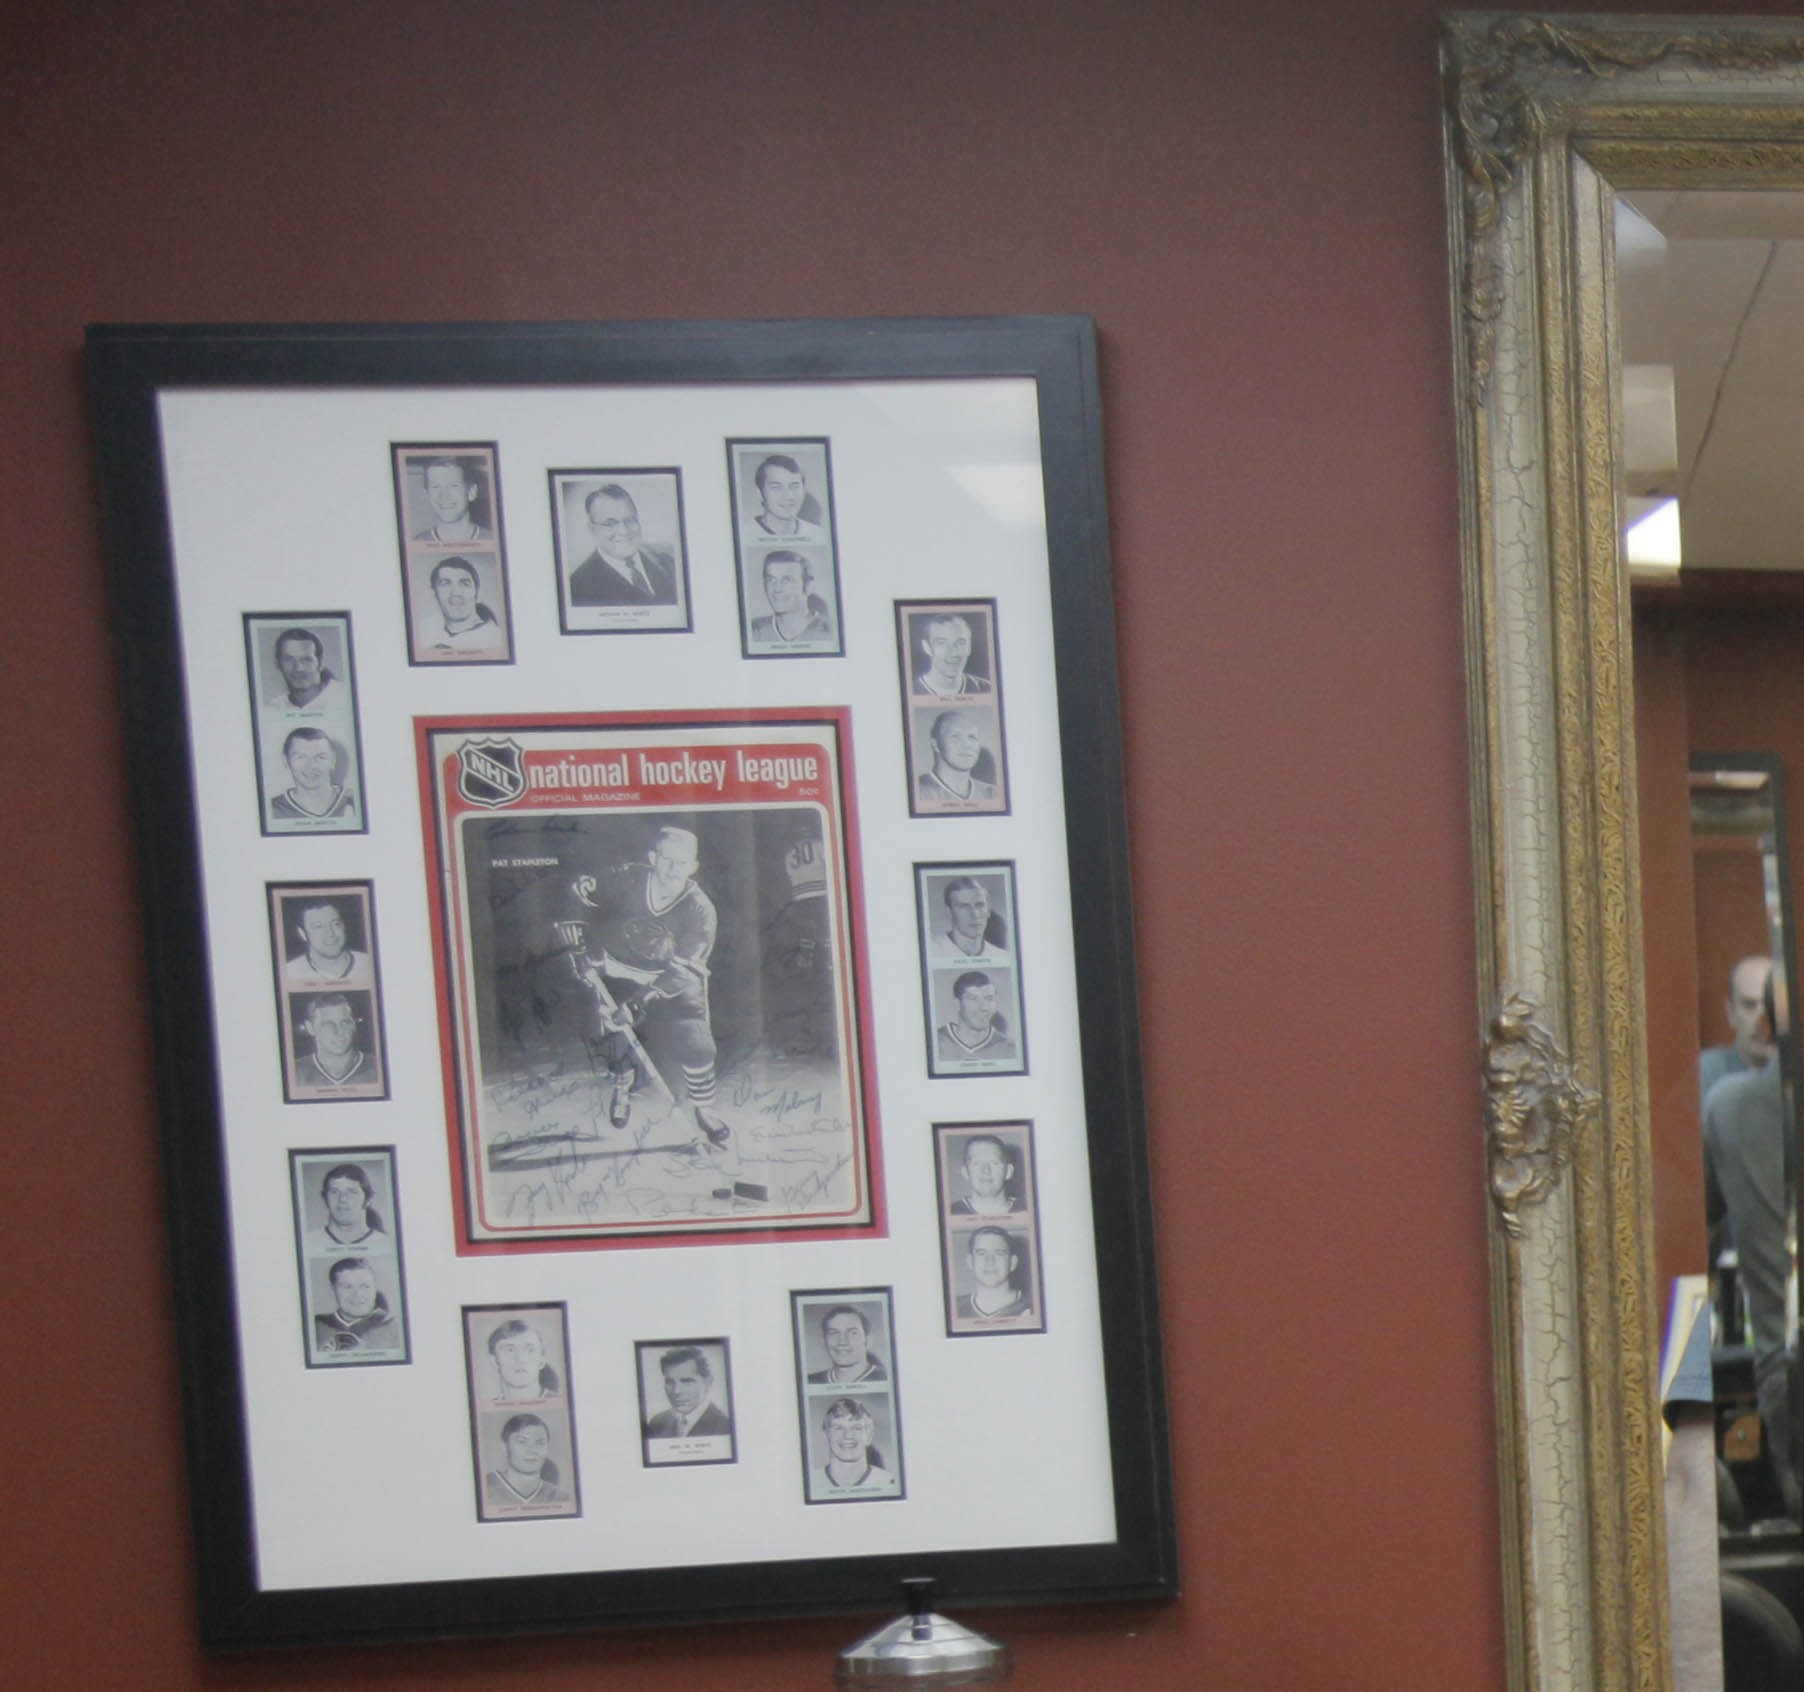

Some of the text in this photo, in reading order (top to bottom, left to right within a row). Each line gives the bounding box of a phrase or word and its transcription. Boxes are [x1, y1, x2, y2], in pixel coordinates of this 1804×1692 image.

[471, 753, 515, 791] NHL
[529, 749, 818, 790] national hockey league
